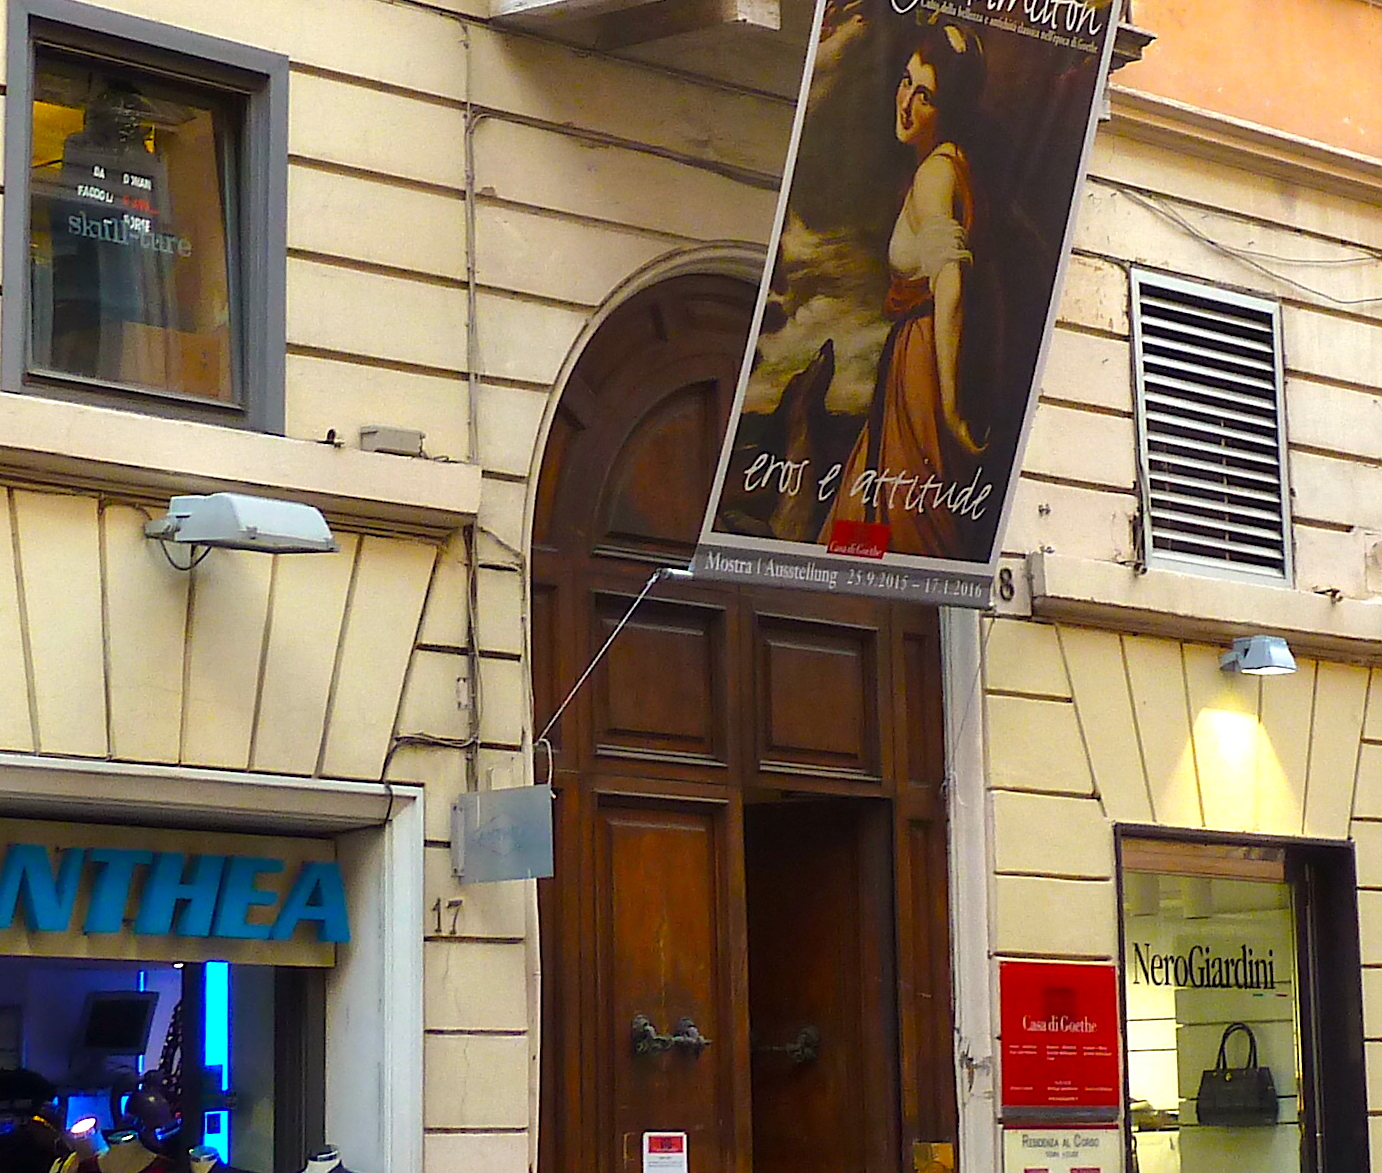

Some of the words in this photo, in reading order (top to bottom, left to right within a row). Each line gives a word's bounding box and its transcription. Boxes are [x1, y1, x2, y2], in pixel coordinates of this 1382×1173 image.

[68, 211, 193, 258] skull-ture
[744, 453, 810, 497] eros
[817, 463, 842, 502] e
[850, 458, 993, 520] attitude
[704, 551, 752, 574] Mostra
[764, 559, 838, 589] Ausstellung
[847, 569, 909, 591] 25.9.2015
[924, 578, 982, 598] 17.1.2016
[432, 897, 463, 935] 17
[1133, 942, 1276, 990] NeroGiardini
[1022, 1015, 1047, 1032] Casa
[1048, 1015, 1059, 1032] di
[1060, 1015, 1098, 1033] Goethe
